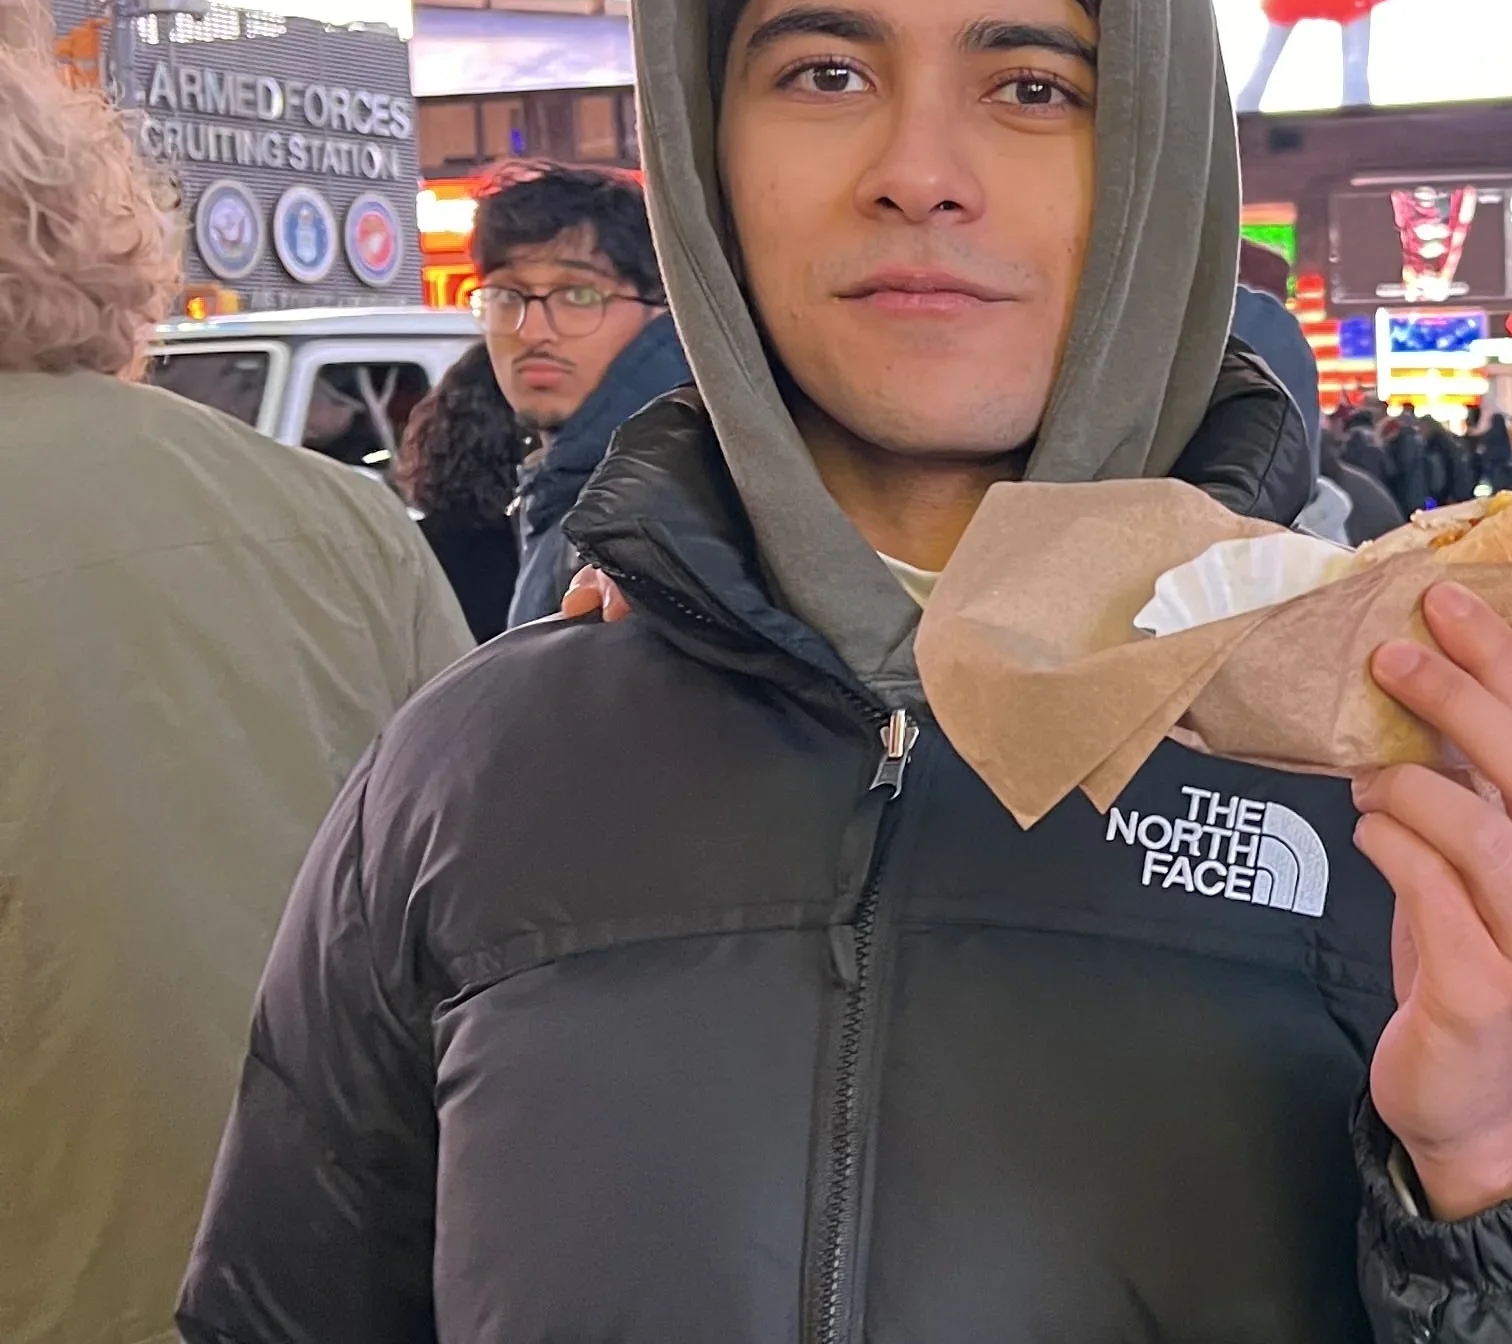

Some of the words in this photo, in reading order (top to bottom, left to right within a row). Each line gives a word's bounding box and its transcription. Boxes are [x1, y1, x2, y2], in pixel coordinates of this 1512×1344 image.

[149, 61, 284, 122] ARMED
[285, 79, 412, 140] FORCES
[287, 132, 403, 181] STATION
[1180, 785, 1266, 835] THE
[1105, 806, 1260, 868] NORTH
[1141, 849, 1256, 902] FACE
